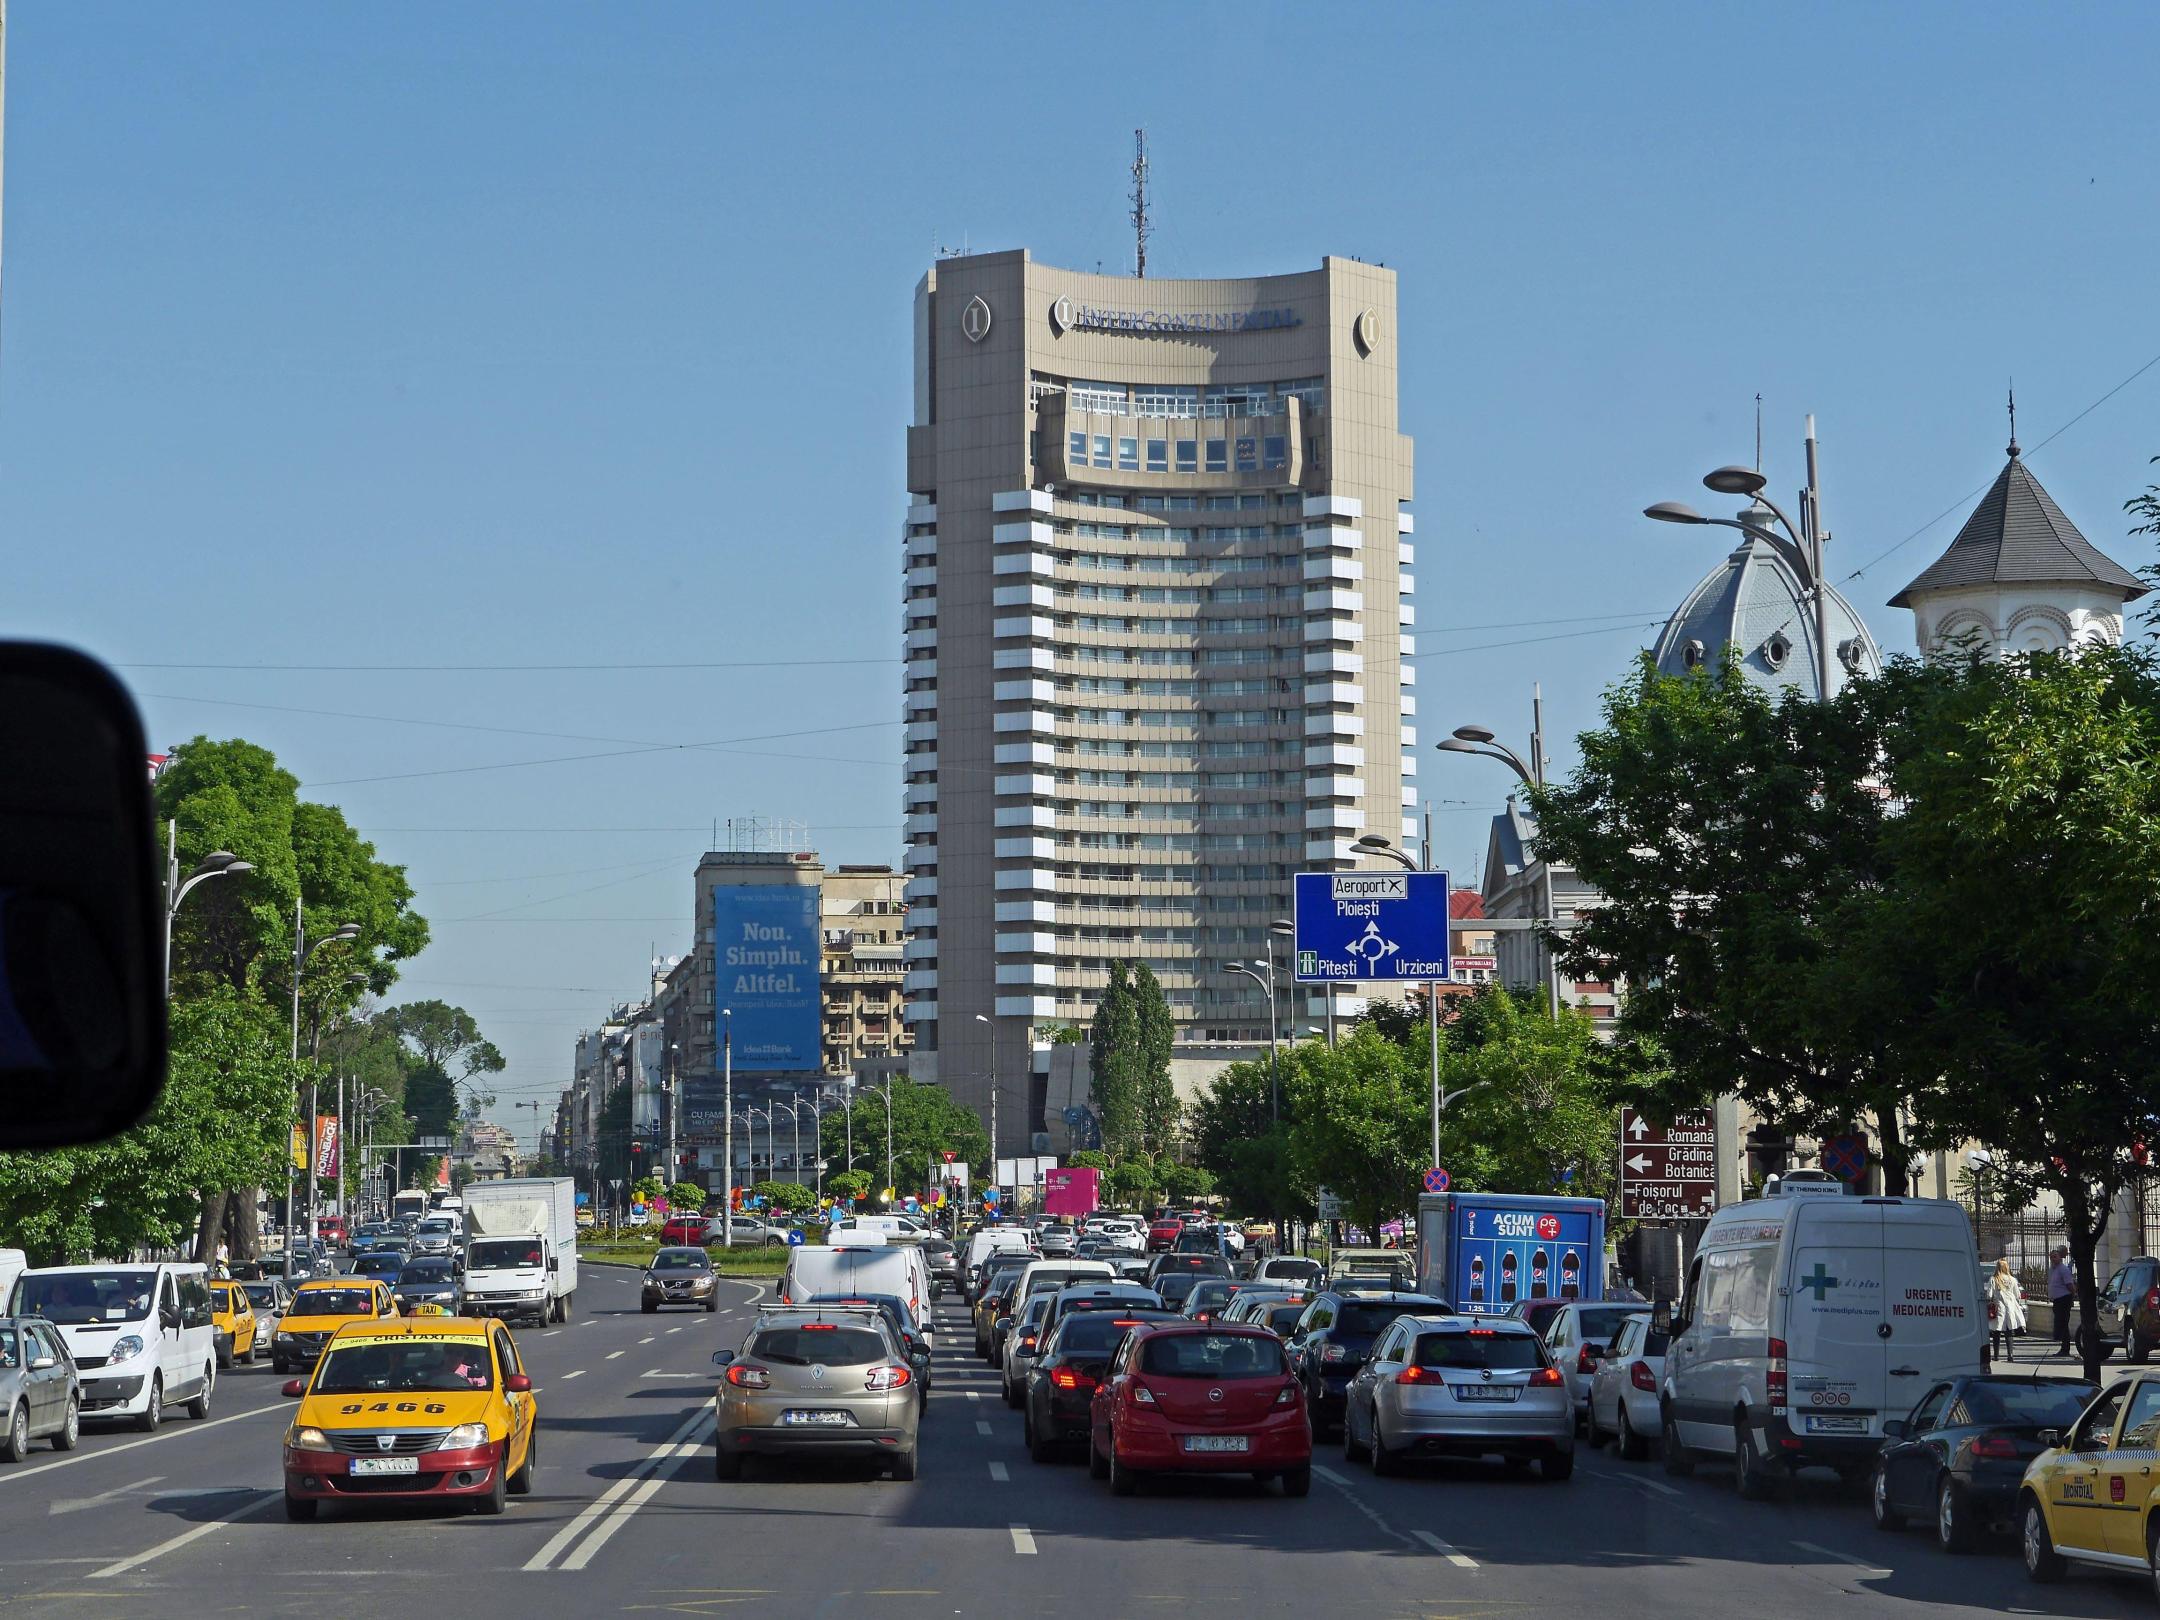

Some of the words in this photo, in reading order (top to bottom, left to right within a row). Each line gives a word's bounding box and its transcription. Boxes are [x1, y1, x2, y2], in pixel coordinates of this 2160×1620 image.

[1335, 878, 1386, 896] Aeroport
[1337, 900, 1379, 919] Ploiești
[742, 922, 793, 941] Nou.
[726, 945, 808, 970] Simplu.
[1318, 959, 1357, 978] Pitești
[1396, 958, 1443, 975] Urziceni
[734, 973, 802, 993] Altfel.
[1667, 1128, 1714, 1143] Romană
[316, 1120, 338, 1177] HORNBACH
[1668, 1147, 1713, 1161] Grădina
[1635, 1183, 1682, 1200] Foișorul
[1639, 1200, 1652, 1214] de
[1493, 1213, 1535, 1226] ACUM
[1540, 1217, 1557, 1227] pe
[1498, 1225, 1536, 1237] SUNT
[422, 1305, 437, 1315] TAXI
[1468, 1304, 1485, 1313] 1,25L
[1811, 1305, 1881, 1316] www.mediplus.com
[1892, 1304, 1965, 1318] MEDICAMENTE
[340, 1402, 446, 1415] 9466
[2063, 1484, 2095, 1500] MONDIAL
